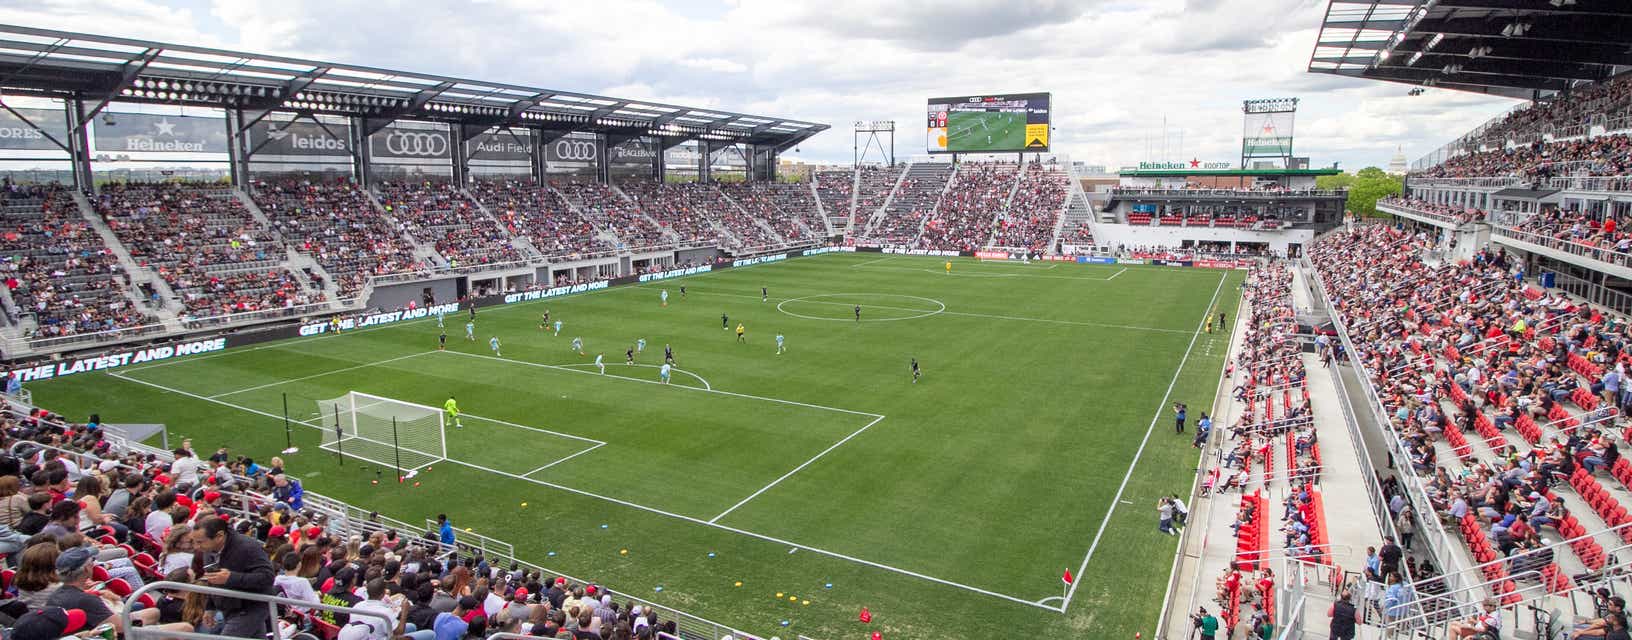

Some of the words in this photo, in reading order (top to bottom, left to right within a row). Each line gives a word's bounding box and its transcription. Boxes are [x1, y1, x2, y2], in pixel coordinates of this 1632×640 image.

[126, 137, 203, 152] Heineken
[291, 133, 345, 150] leidos
[476, 141, 505, 152] Audi
[507, 142, 533, 153] Field
[1139, 161, 1185, 169] Heineken
[504, 292, 523, 303] GET
[524, 290, 541, 301] THE
[541, 285, 572, 298] LATEST
[570, 284, 588, 293] AND
[588, 280, 609, 291] MORE
[299, 322, 329, 336] GET
[358, 311, 403, 327] LATEST
[402, 307, 427, 320] AND
[429, 302, 460, 315] MORE
[12, 364, 56, 382] THE
[57, 353, 133, 376] LATEST
[132, 346, 174, 363] AND
[175, 338, 226, 356] MORE
